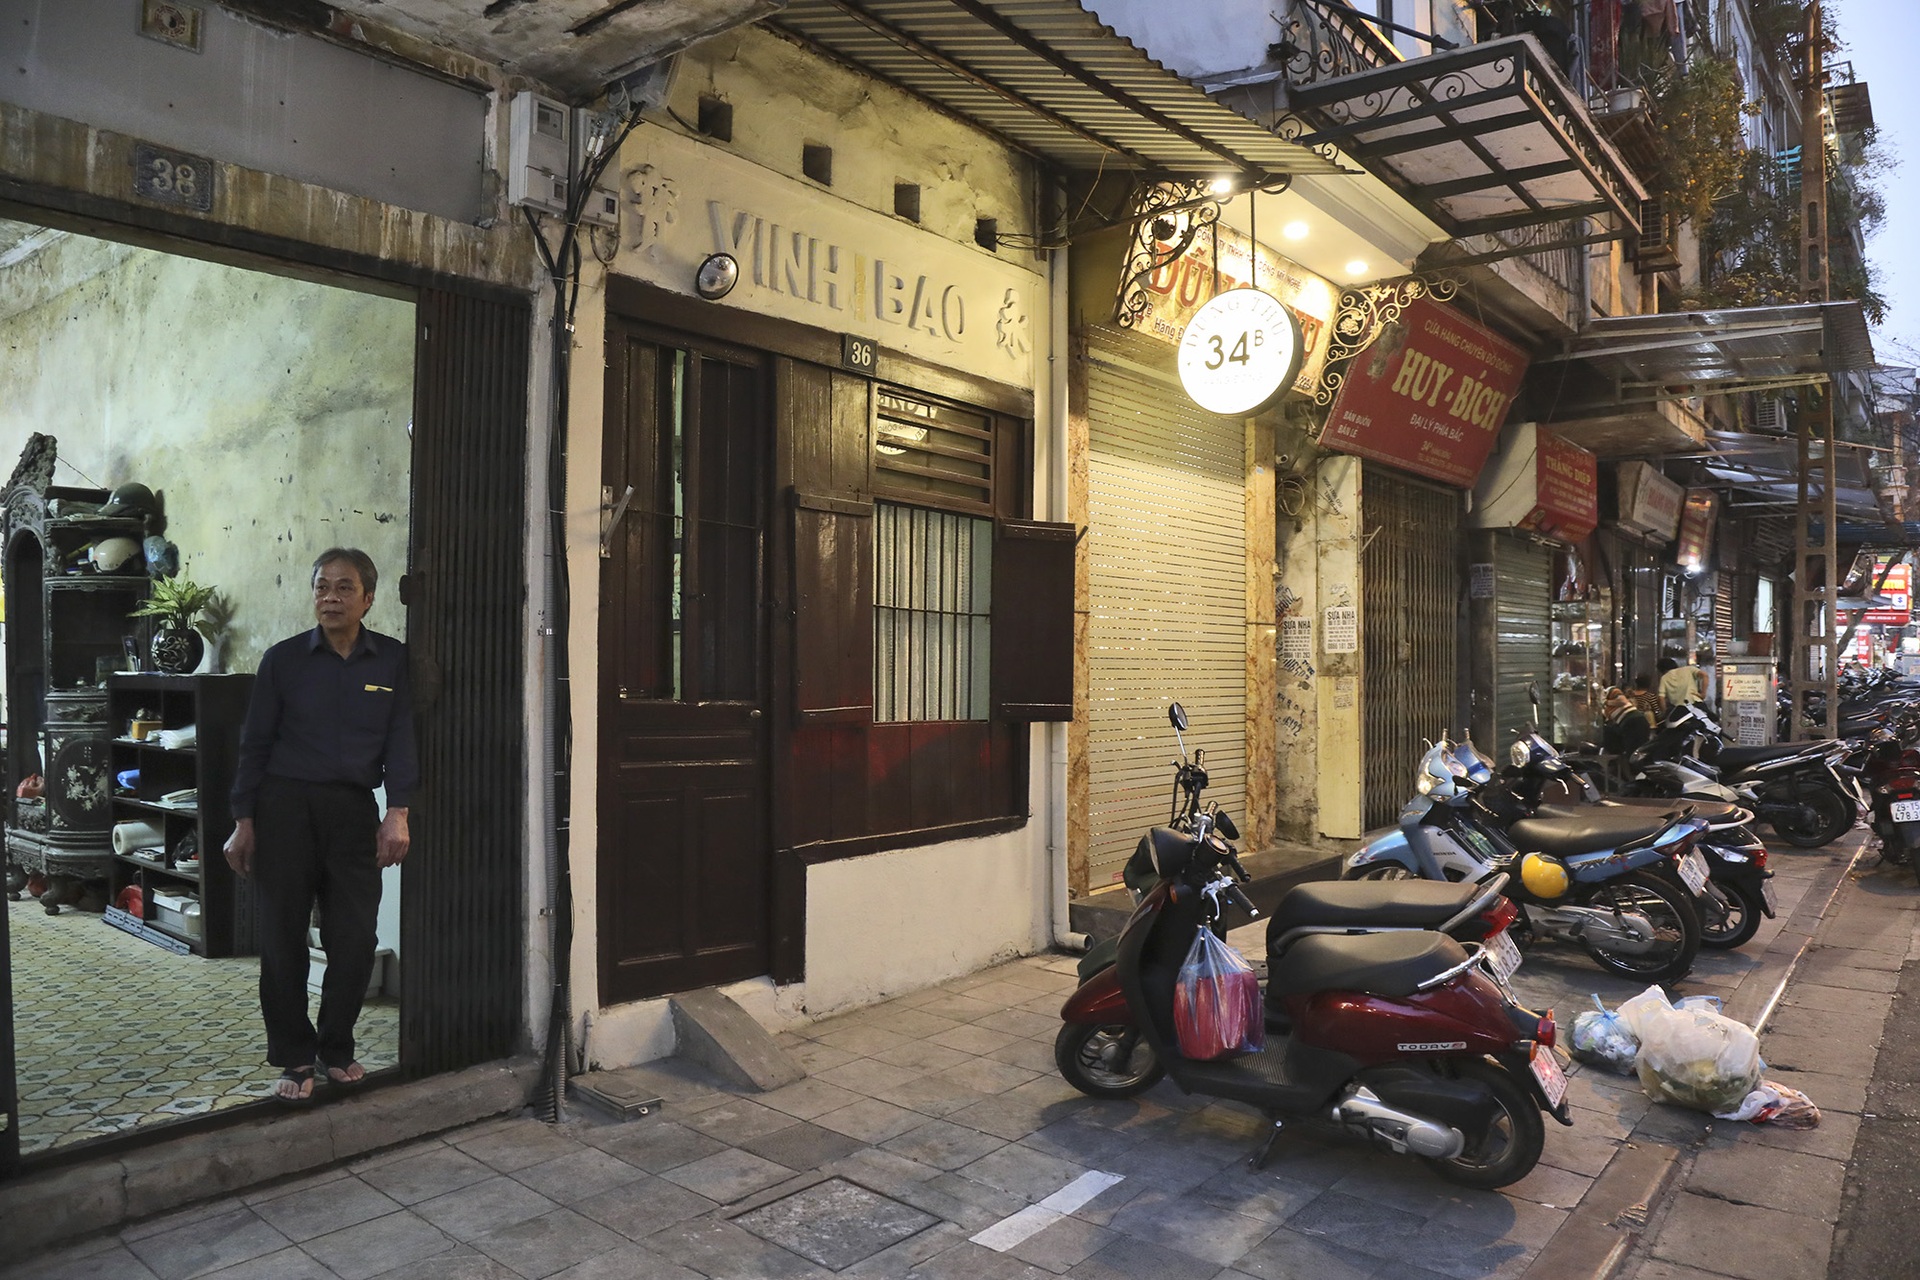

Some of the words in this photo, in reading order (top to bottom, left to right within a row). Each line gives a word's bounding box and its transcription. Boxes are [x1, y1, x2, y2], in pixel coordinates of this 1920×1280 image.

[152, 158, 196, 196] 38
[708, 200, 843, 312] VINH
[851, 341, 872, 366] 36
[1391, 348, 1454, 407] HUY
[1449, 370, 1507, 431] BÍCH
[1398, 1043, 1449, 1051] TODAY
